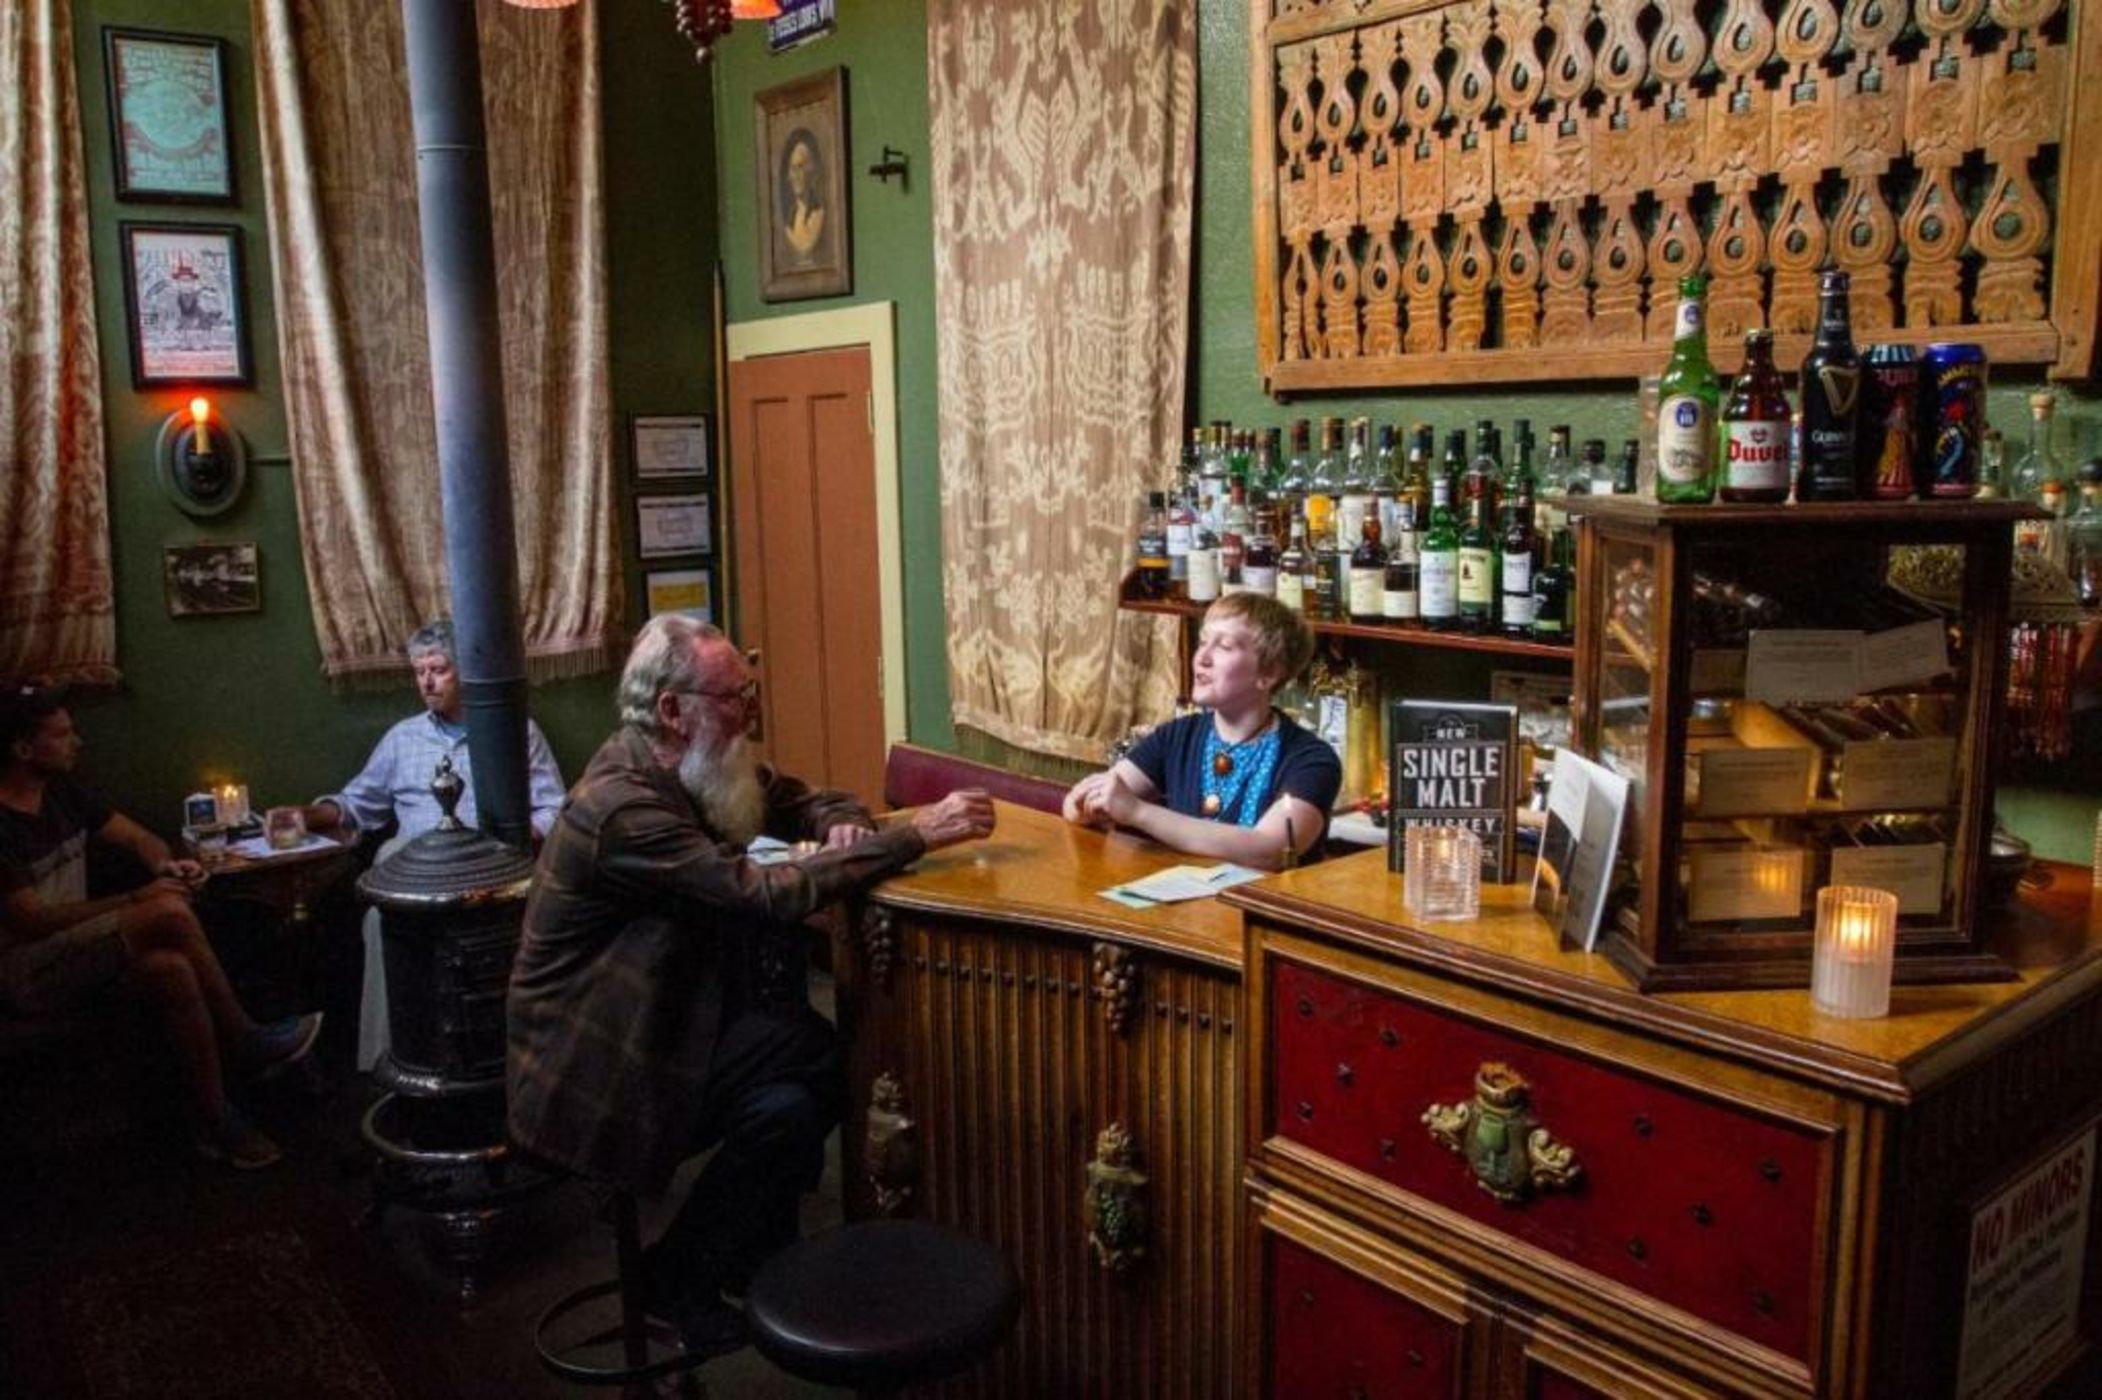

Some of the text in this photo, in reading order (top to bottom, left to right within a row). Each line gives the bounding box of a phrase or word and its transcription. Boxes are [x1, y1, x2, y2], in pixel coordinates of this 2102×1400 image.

[1728, 438, 1788, 463] Duvel
[1437, 728, 1466, 740] NEW
[1403, 747, 1500, 778] SINGLE
[1416, 778, 1486, 808] MALT
